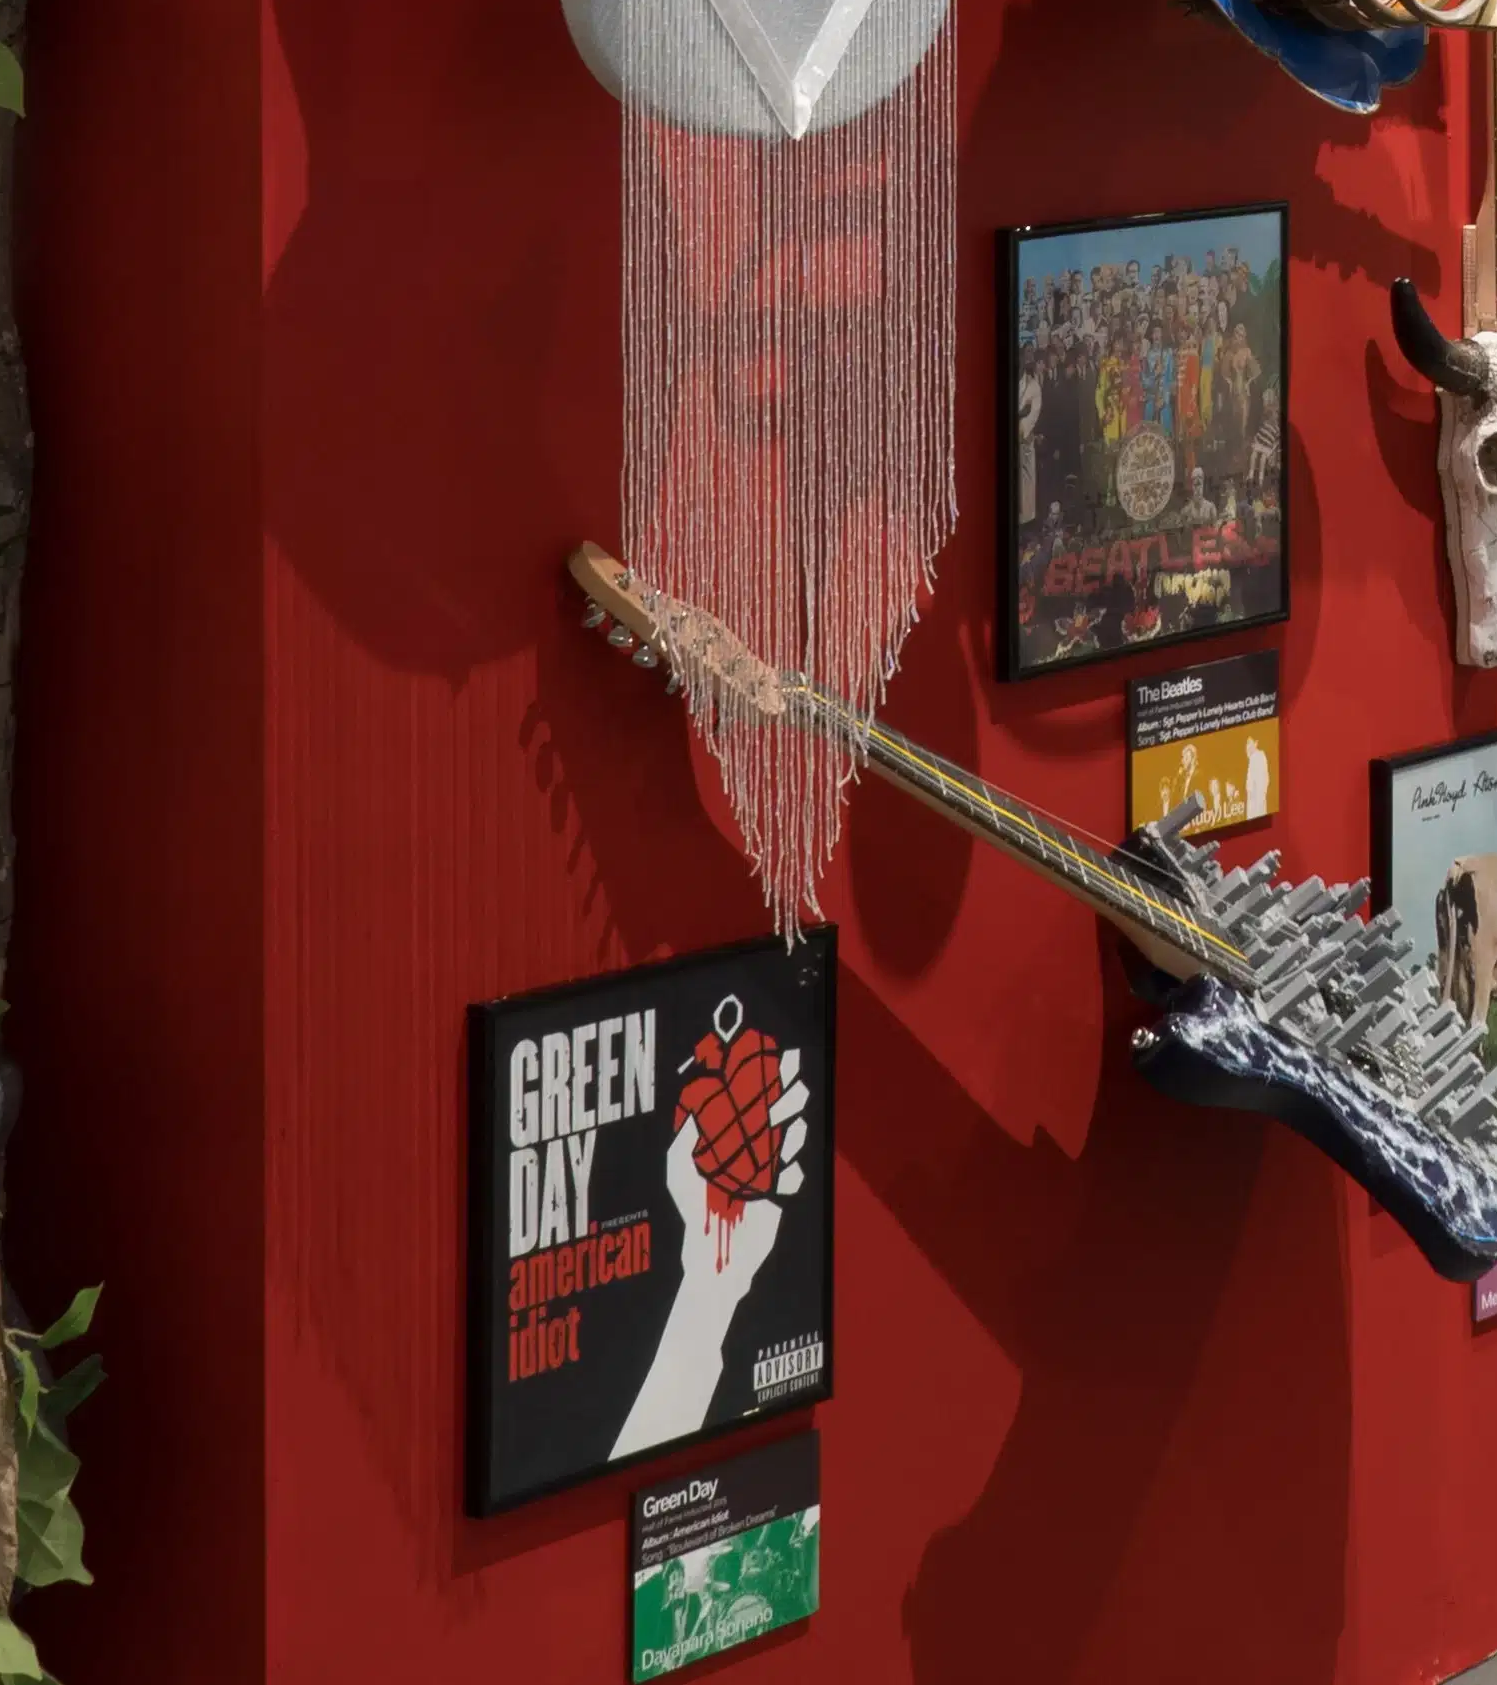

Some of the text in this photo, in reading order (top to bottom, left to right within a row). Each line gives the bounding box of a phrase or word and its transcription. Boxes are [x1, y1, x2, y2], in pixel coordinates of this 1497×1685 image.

[1043, 520, 1255, 597] BEATLES
[1137, 675, 1203, 704] The Beatles
[509, 1008, 656, 1149] GREEN
[509, 1129, 598, 1259] DAY
[601, 1209, 648, 1229] PRESENTS
[509, 1220, 652, 1311] american
[509, 1306, 581, 1383] idiot
[758, 1330, 819, 1361] PARENTAL
[756, 1346, 820, 1388] ADVISORY
[758, 1380, 788, 1404] EXPLICIT
[642, 1478, 720, 1519] Green Day
[673, 1518, 710, 1539] American
